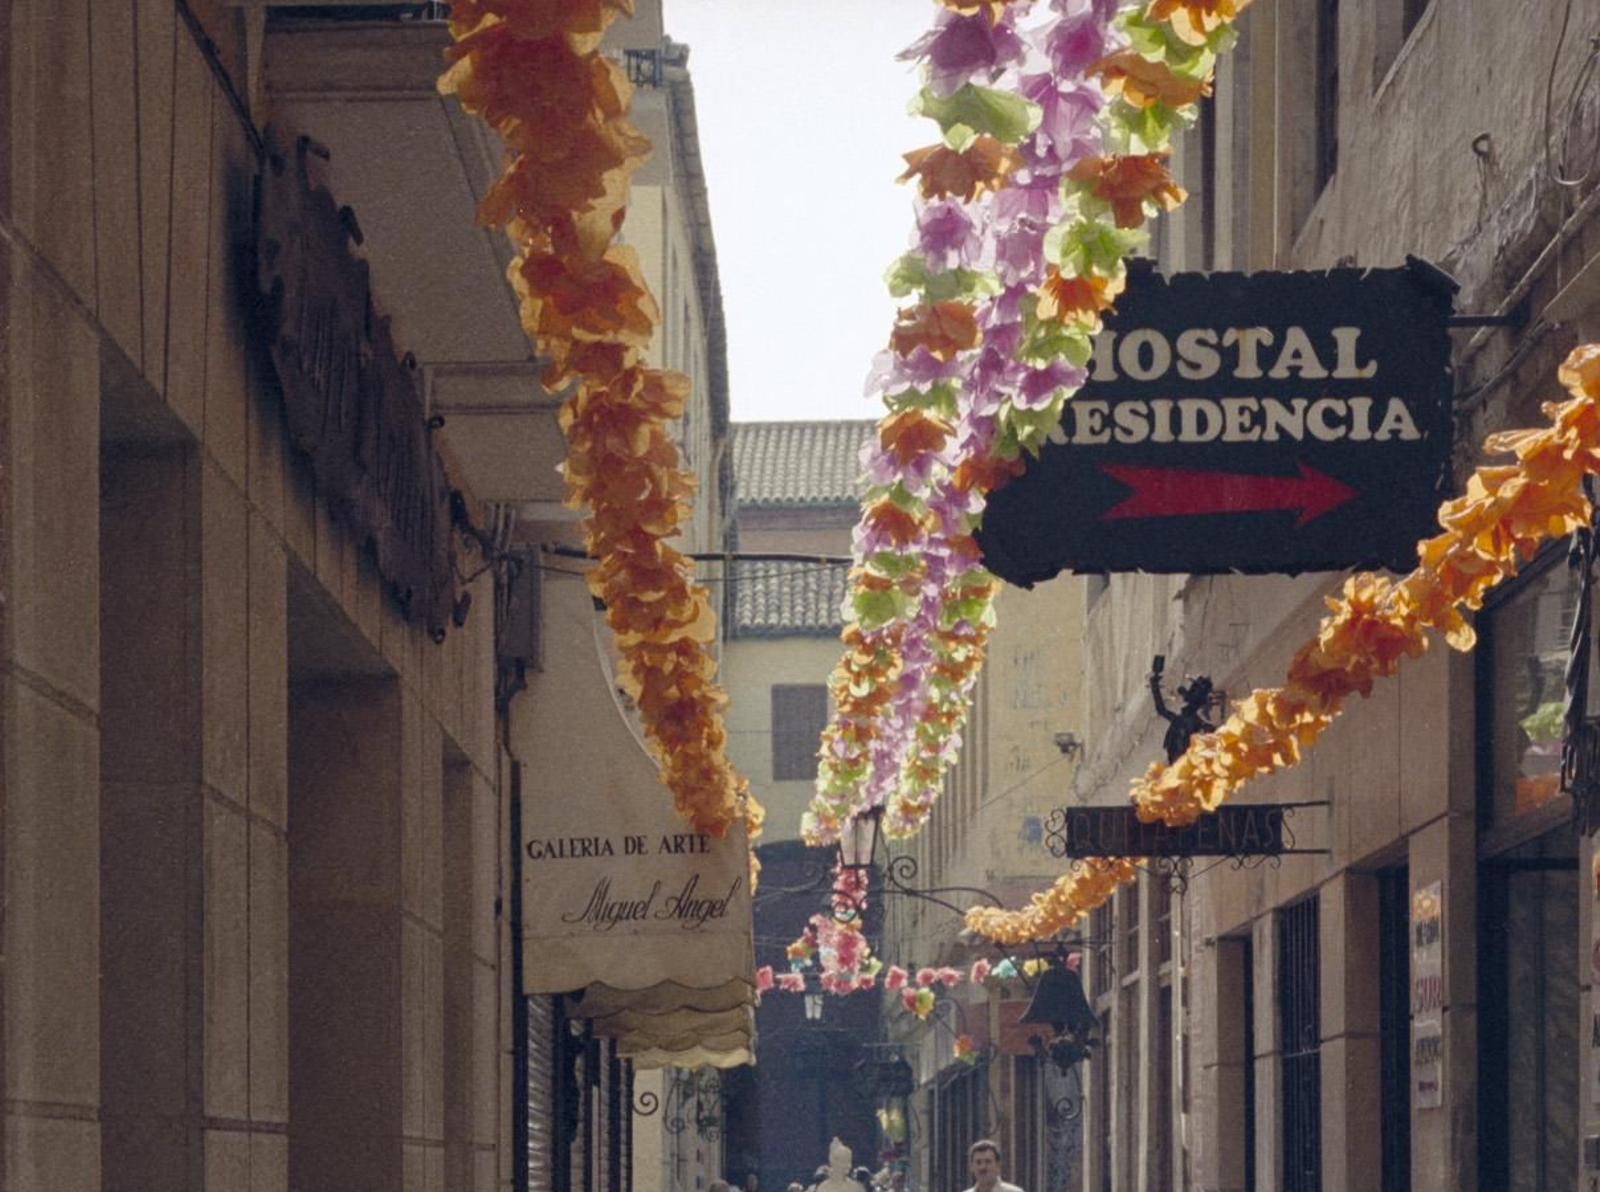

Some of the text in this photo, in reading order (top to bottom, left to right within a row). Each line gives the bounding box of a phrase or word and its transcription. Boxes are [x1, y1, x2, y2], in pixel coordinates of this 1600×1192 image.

[527, 833, 711, 860] GALERIA DE ARTE
[561, 874, 742, 932] Miguel Angel
